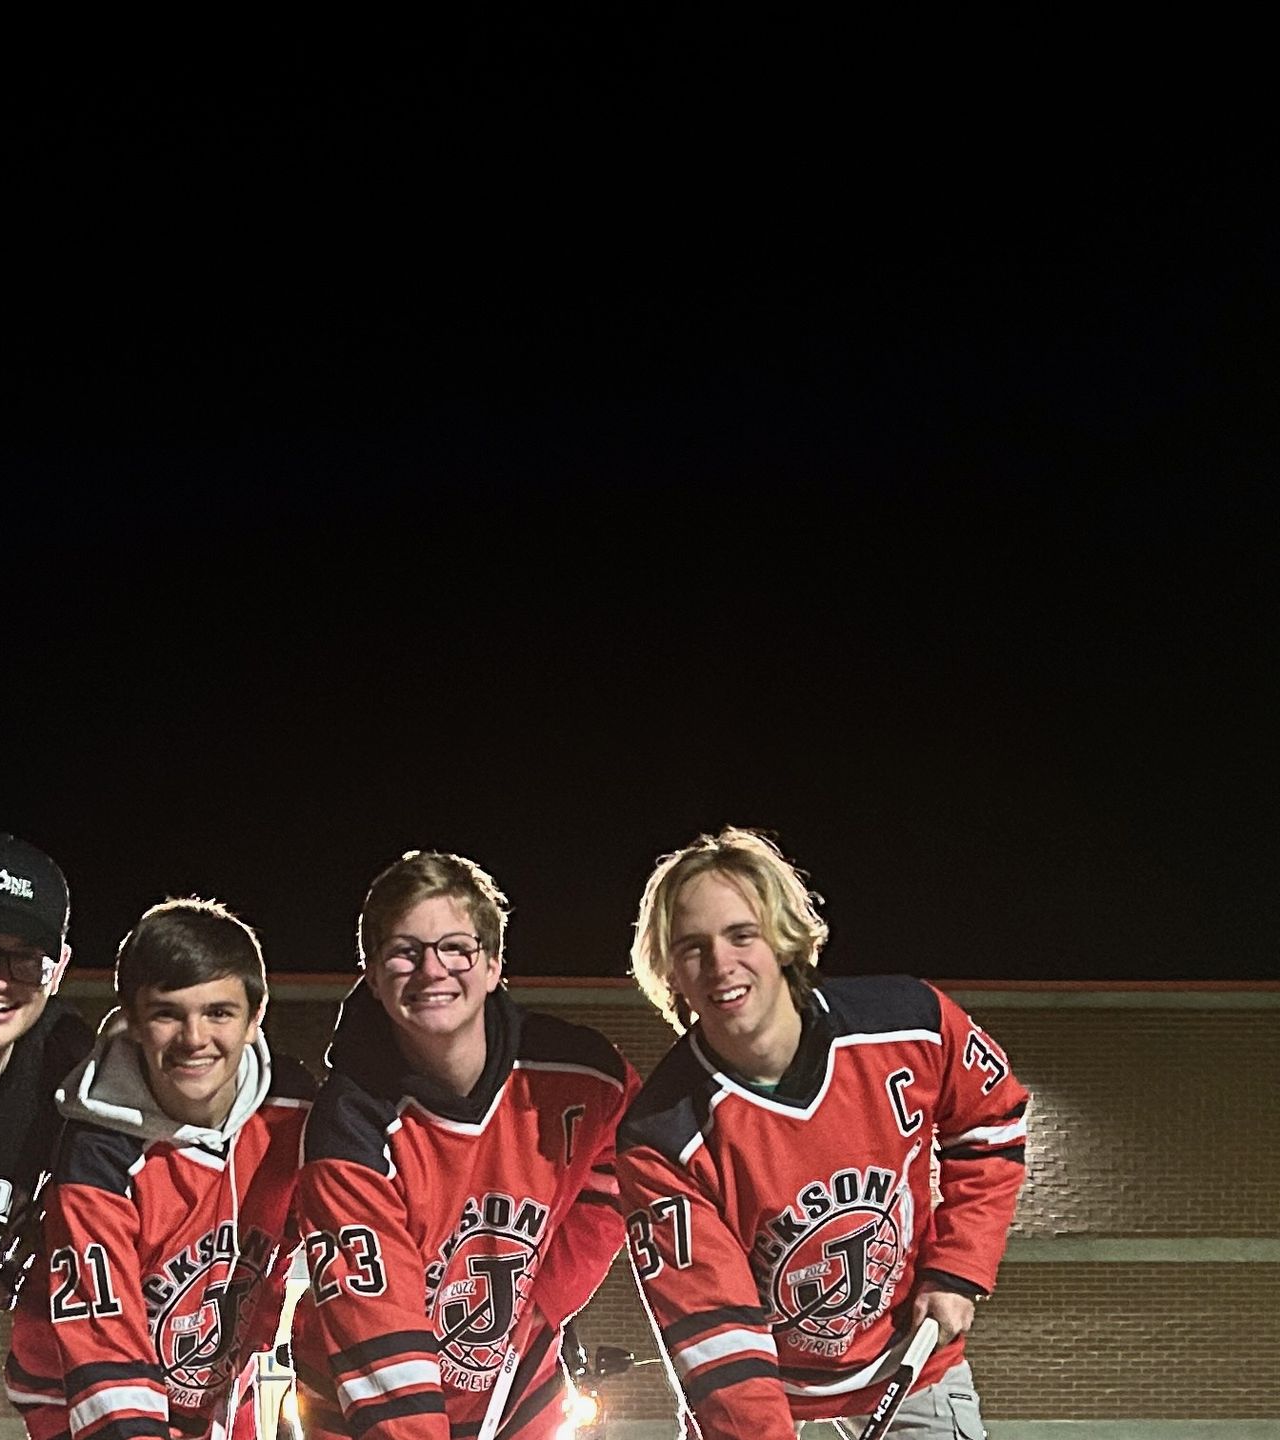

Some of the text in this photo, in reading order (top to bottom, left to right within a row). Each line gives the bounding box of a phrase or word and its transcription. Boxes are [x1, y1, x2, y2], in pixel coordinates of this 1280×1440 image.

[963, 1016, 1010, 1096] 3
[885, 1066, 924, 1138] C
[305, 1223, 388, 1307] 23
[625, 1194, 693, 1281] 37
[803, 1261, 830, 1278] 2022
[50, 1242, 123, 1324] 21
[449, 1280, 477, 1297] 2022
[438, 1357, 496, 1392] STREE
[873, 1380, 900, 1423] CCM
